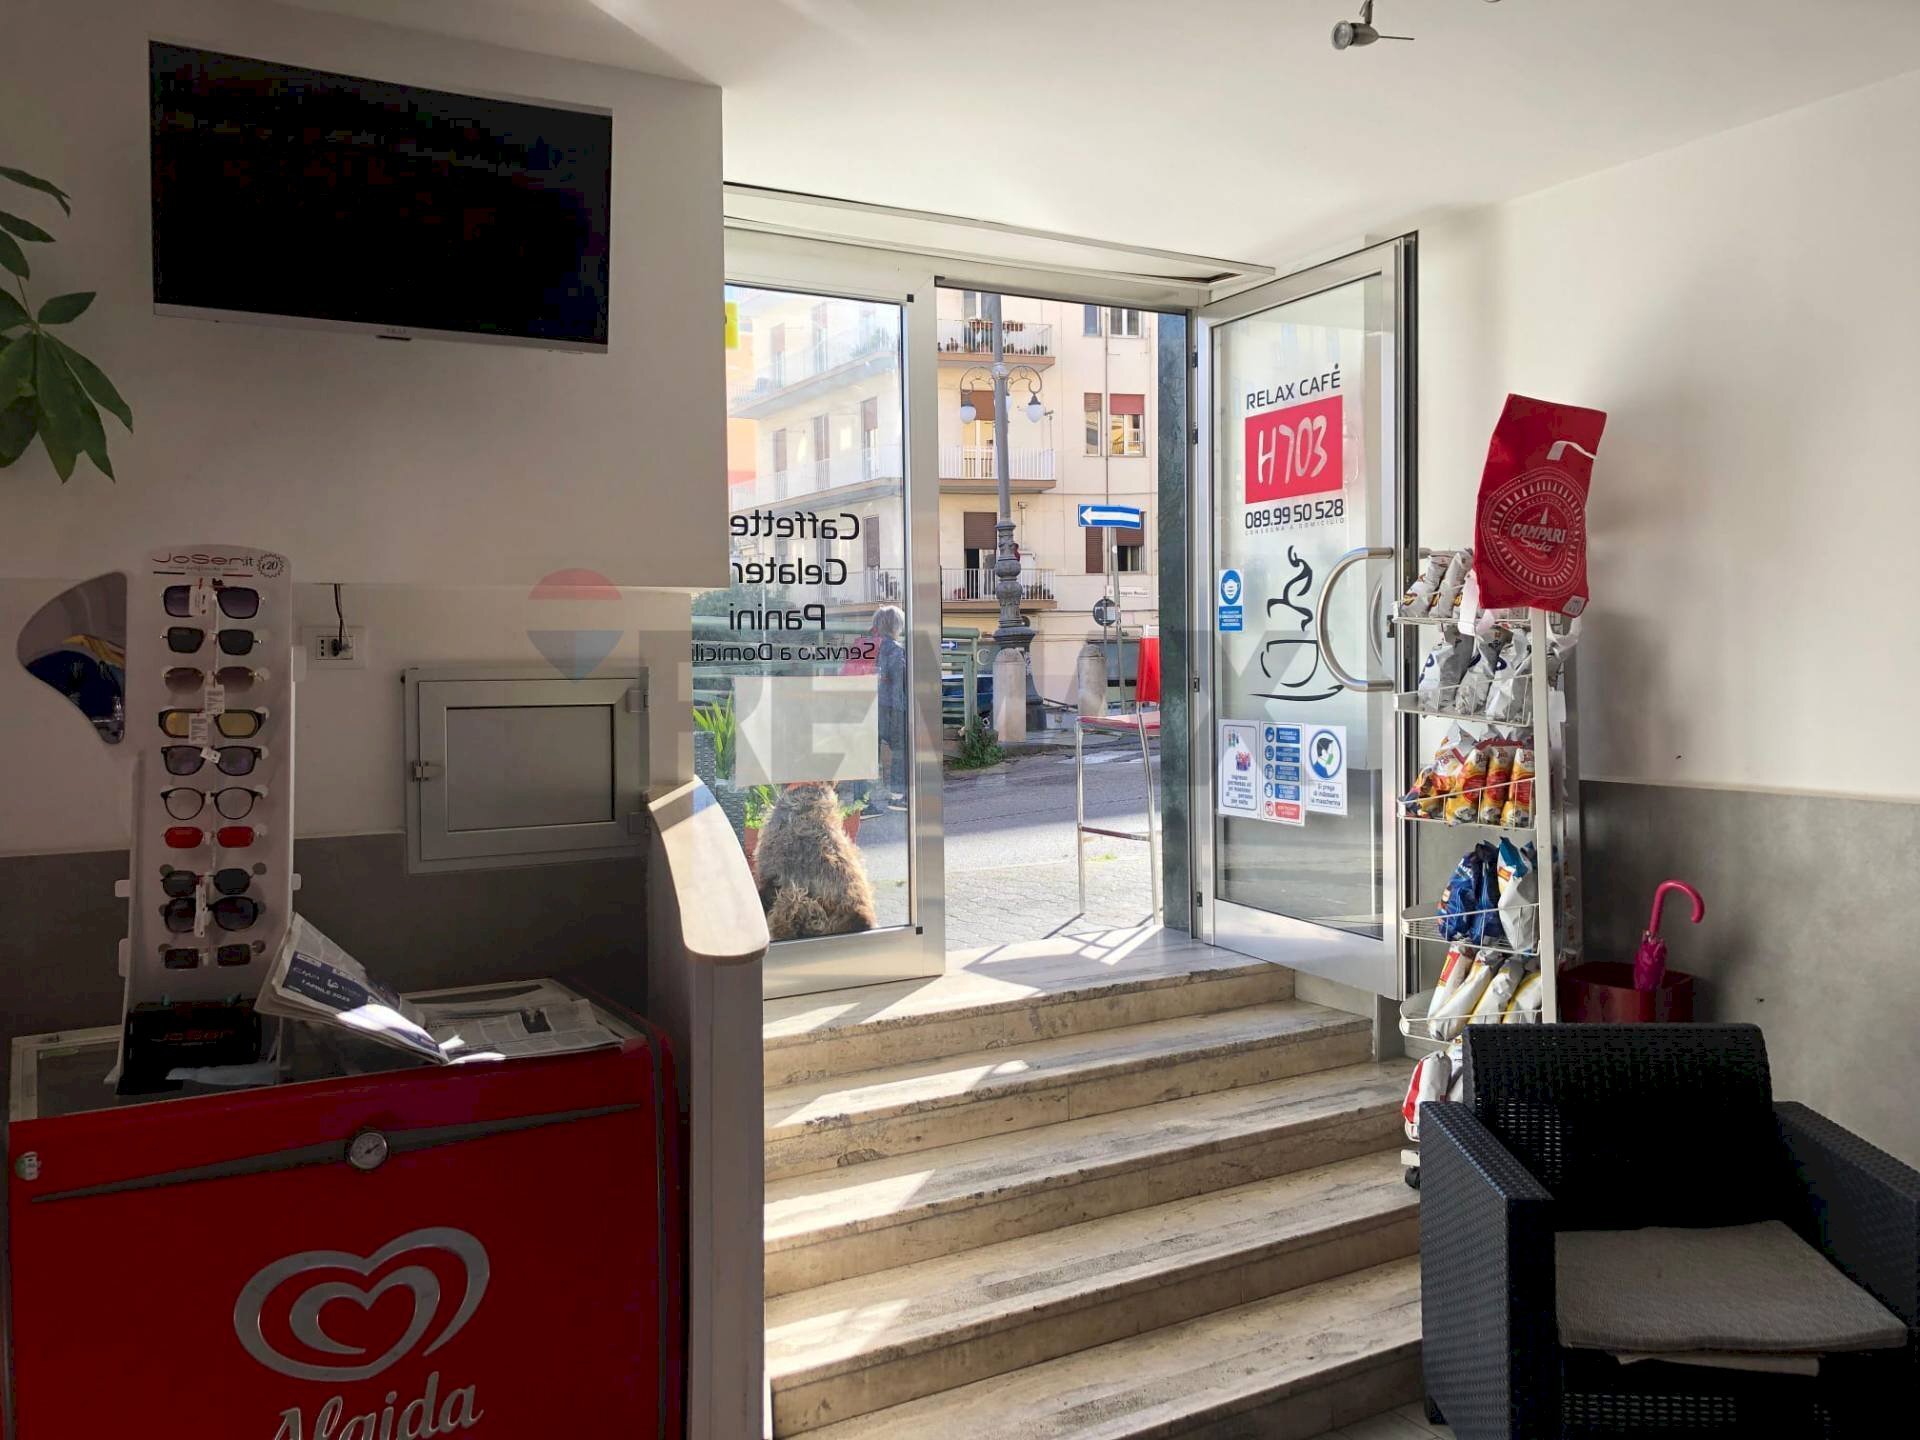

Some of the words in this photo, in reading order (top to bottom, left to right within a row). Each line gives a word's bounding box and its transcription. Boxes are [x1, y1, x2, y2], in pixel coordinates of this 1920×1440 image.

[1246, 383, 1294, 410] RELAX
[1300, 363, 1341, 396] CAFÉ
[1257, 415, 1328, 485] H703
[1245, 506, 1290, 529] 089.99
[1293, 503, 1312, 523] 50
[1315, 498, 1343, 520] 528
[1510, 523, 1567, 544] CAMPARI
[1519, 536, 1554, 553] Soda
